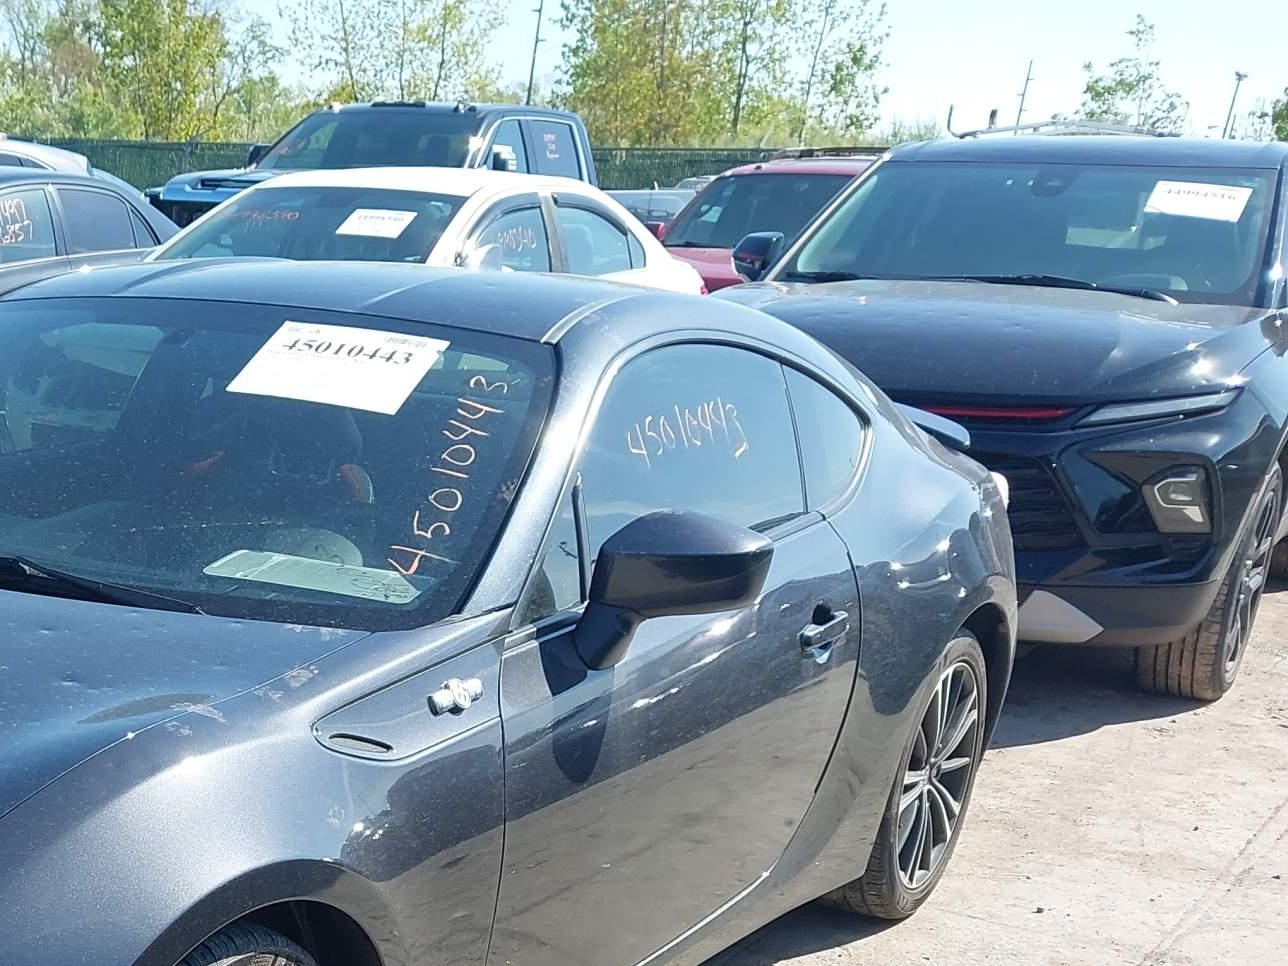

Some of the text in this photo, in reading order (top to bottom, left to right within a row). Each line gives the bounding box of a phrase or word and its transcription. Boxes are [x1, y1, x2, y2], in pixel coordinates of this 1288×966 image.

[282, 337, 414, 366] 45010443
[626, 396, 750, 469] 45010443
[387, 375, 508, 575] 45010443
